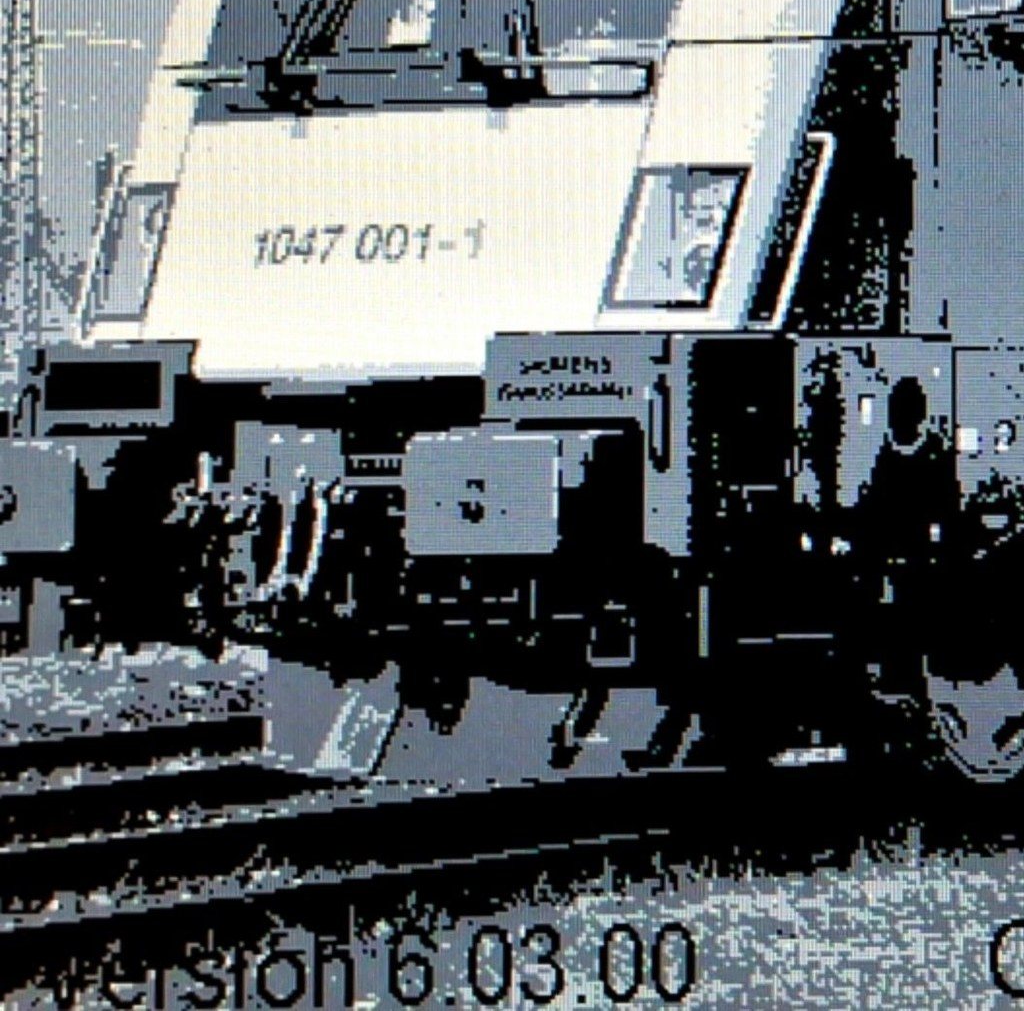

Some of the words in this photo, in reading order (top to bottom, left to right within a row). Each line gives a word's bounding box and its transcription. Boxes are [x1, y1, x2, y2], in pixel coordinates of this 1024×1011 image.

[254, 223, 345, 268] 1047
[355, 218, 485, 265] 001-1
[388, 922, 697, 1007] 6.03.00
